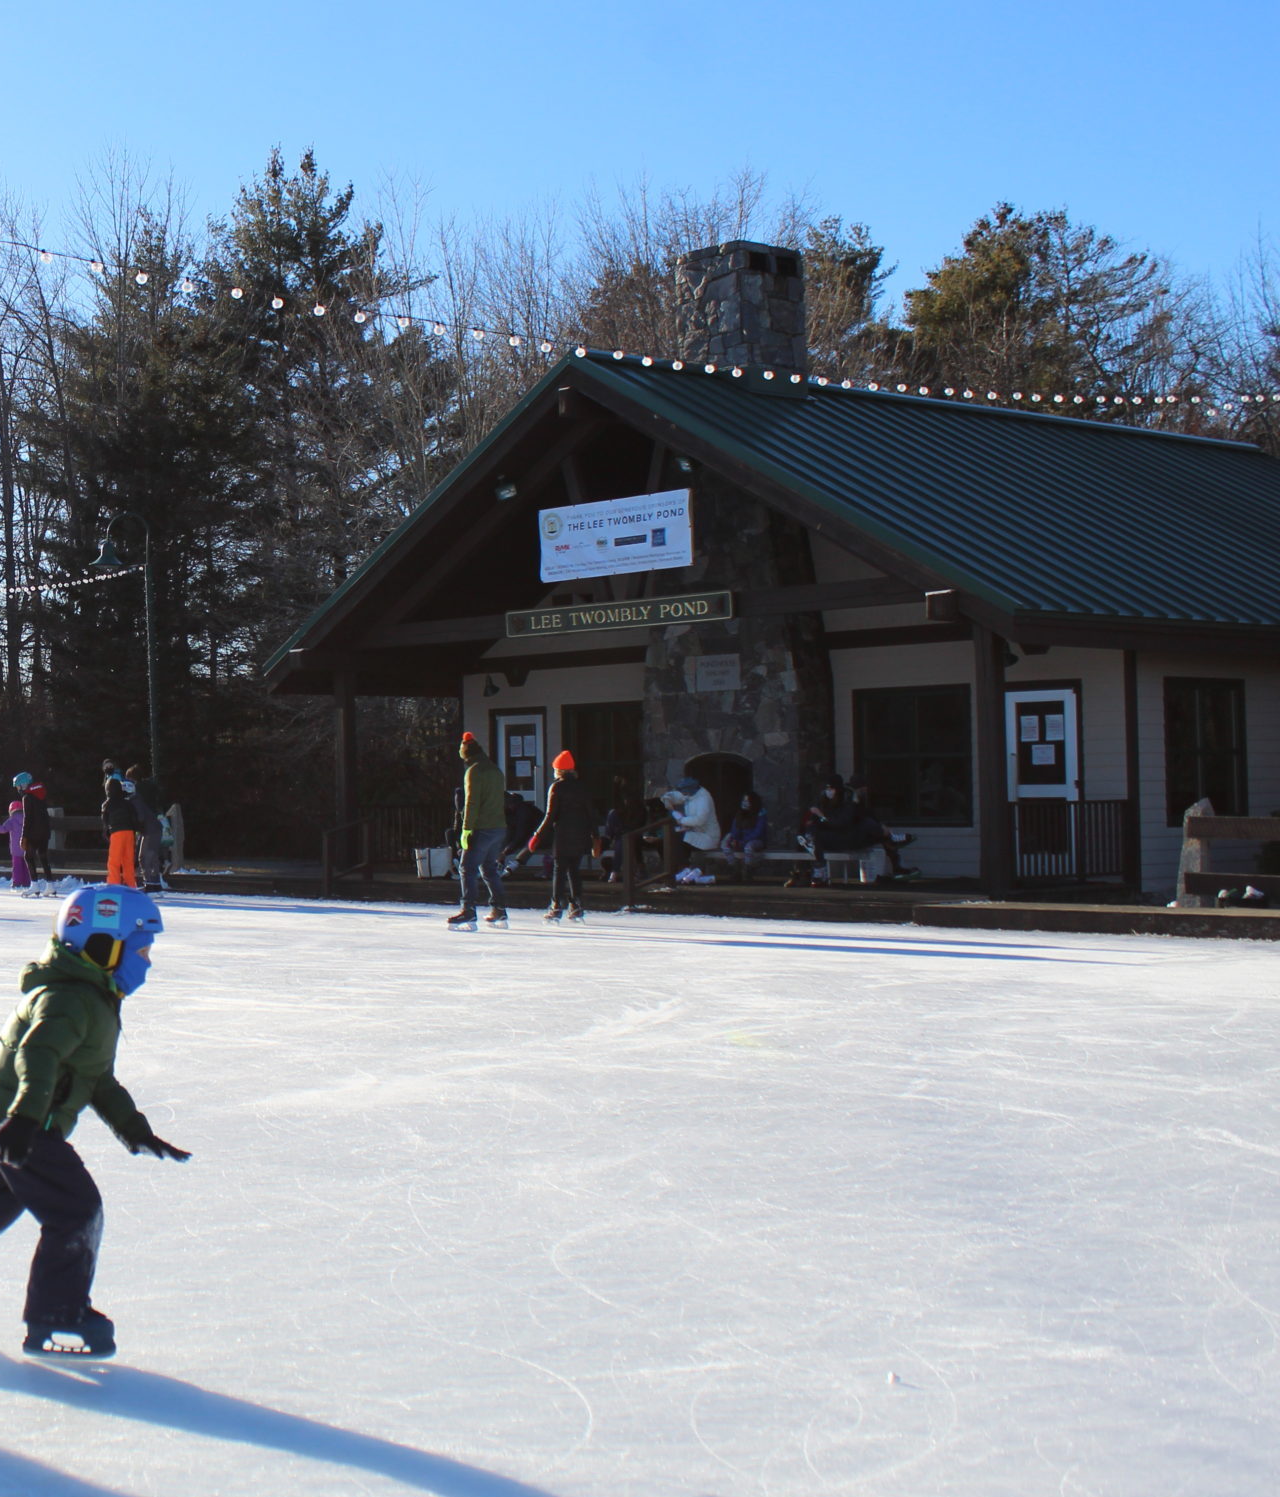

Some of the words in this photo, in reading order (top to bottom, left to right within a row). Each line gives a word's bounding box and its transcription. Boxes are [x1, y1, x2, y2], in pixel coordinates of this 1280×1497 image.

[568, 522, 585, 532] THE
[587, 520, 604, 530] LEE
[608, 512, 654, 527] TWOMBLY
[657, 508, 684, 519] POND
[531, 614, 562, 630] LEE
[569, 606, 651, 626] TWOMBLY
[660, 600, 708, 618] POND
